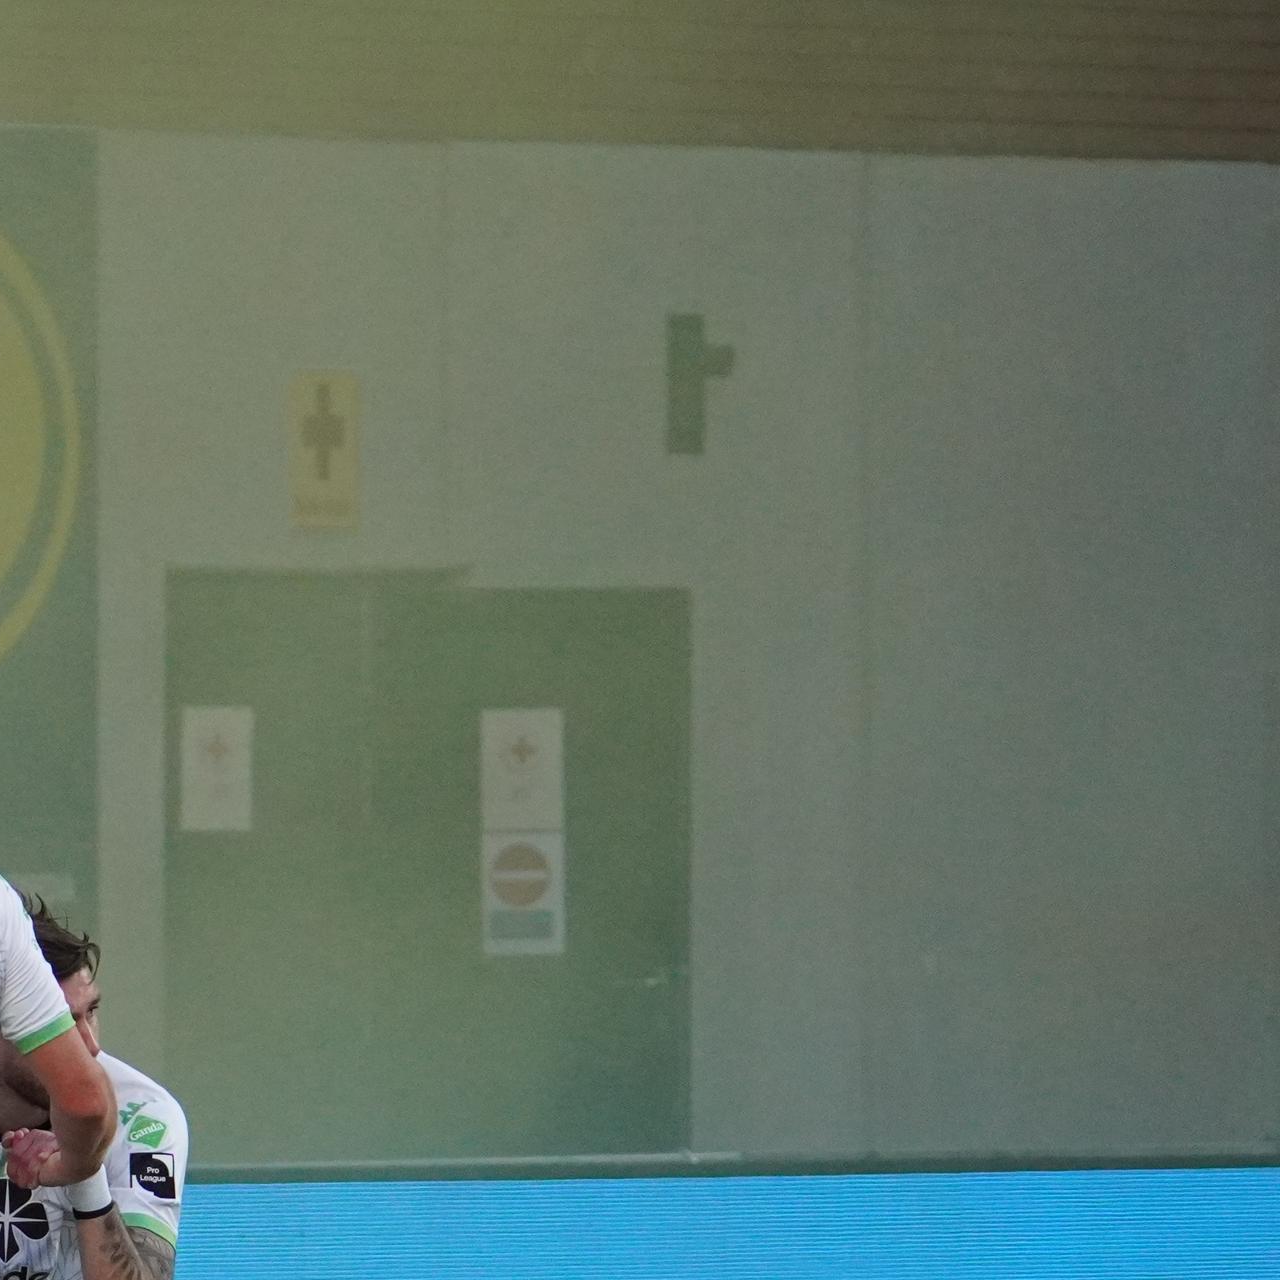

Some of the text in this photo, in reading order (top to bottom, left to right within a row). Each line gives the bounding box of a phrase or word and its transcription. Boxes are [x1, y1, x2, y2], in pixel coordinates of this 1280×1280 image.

[130, 1122, 164, 1141] Ganda
[146, 1166, 160, 1174] Pro
[140, 1174, 166, 1184] League
